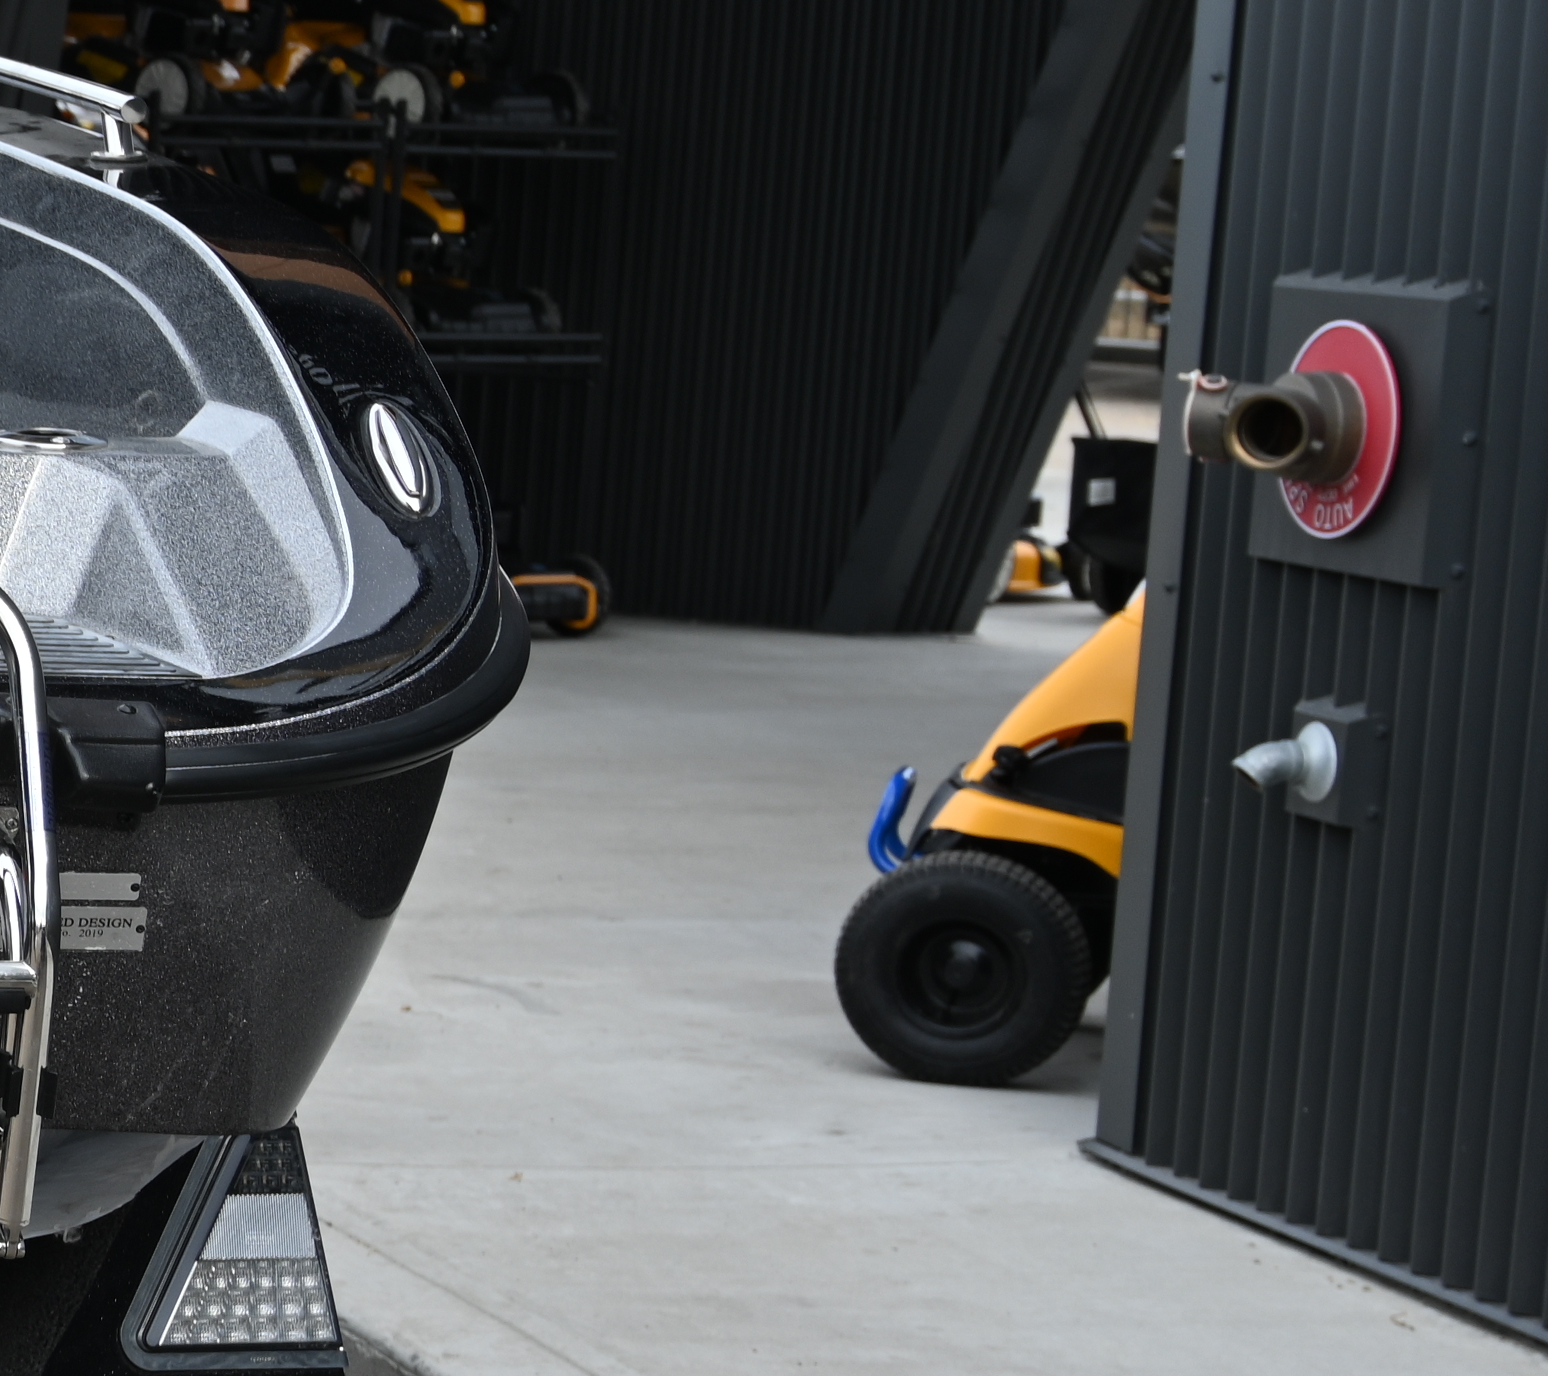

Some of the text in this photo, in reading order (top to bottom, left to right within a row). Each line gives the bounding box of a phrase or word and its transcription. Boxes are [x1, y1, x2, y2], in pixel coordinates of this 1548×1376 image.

[1314, 496, 1354, 530] AUTO
[78, 917, 133, 929] DESIGN
[78, 929, 104, 938] 2019
